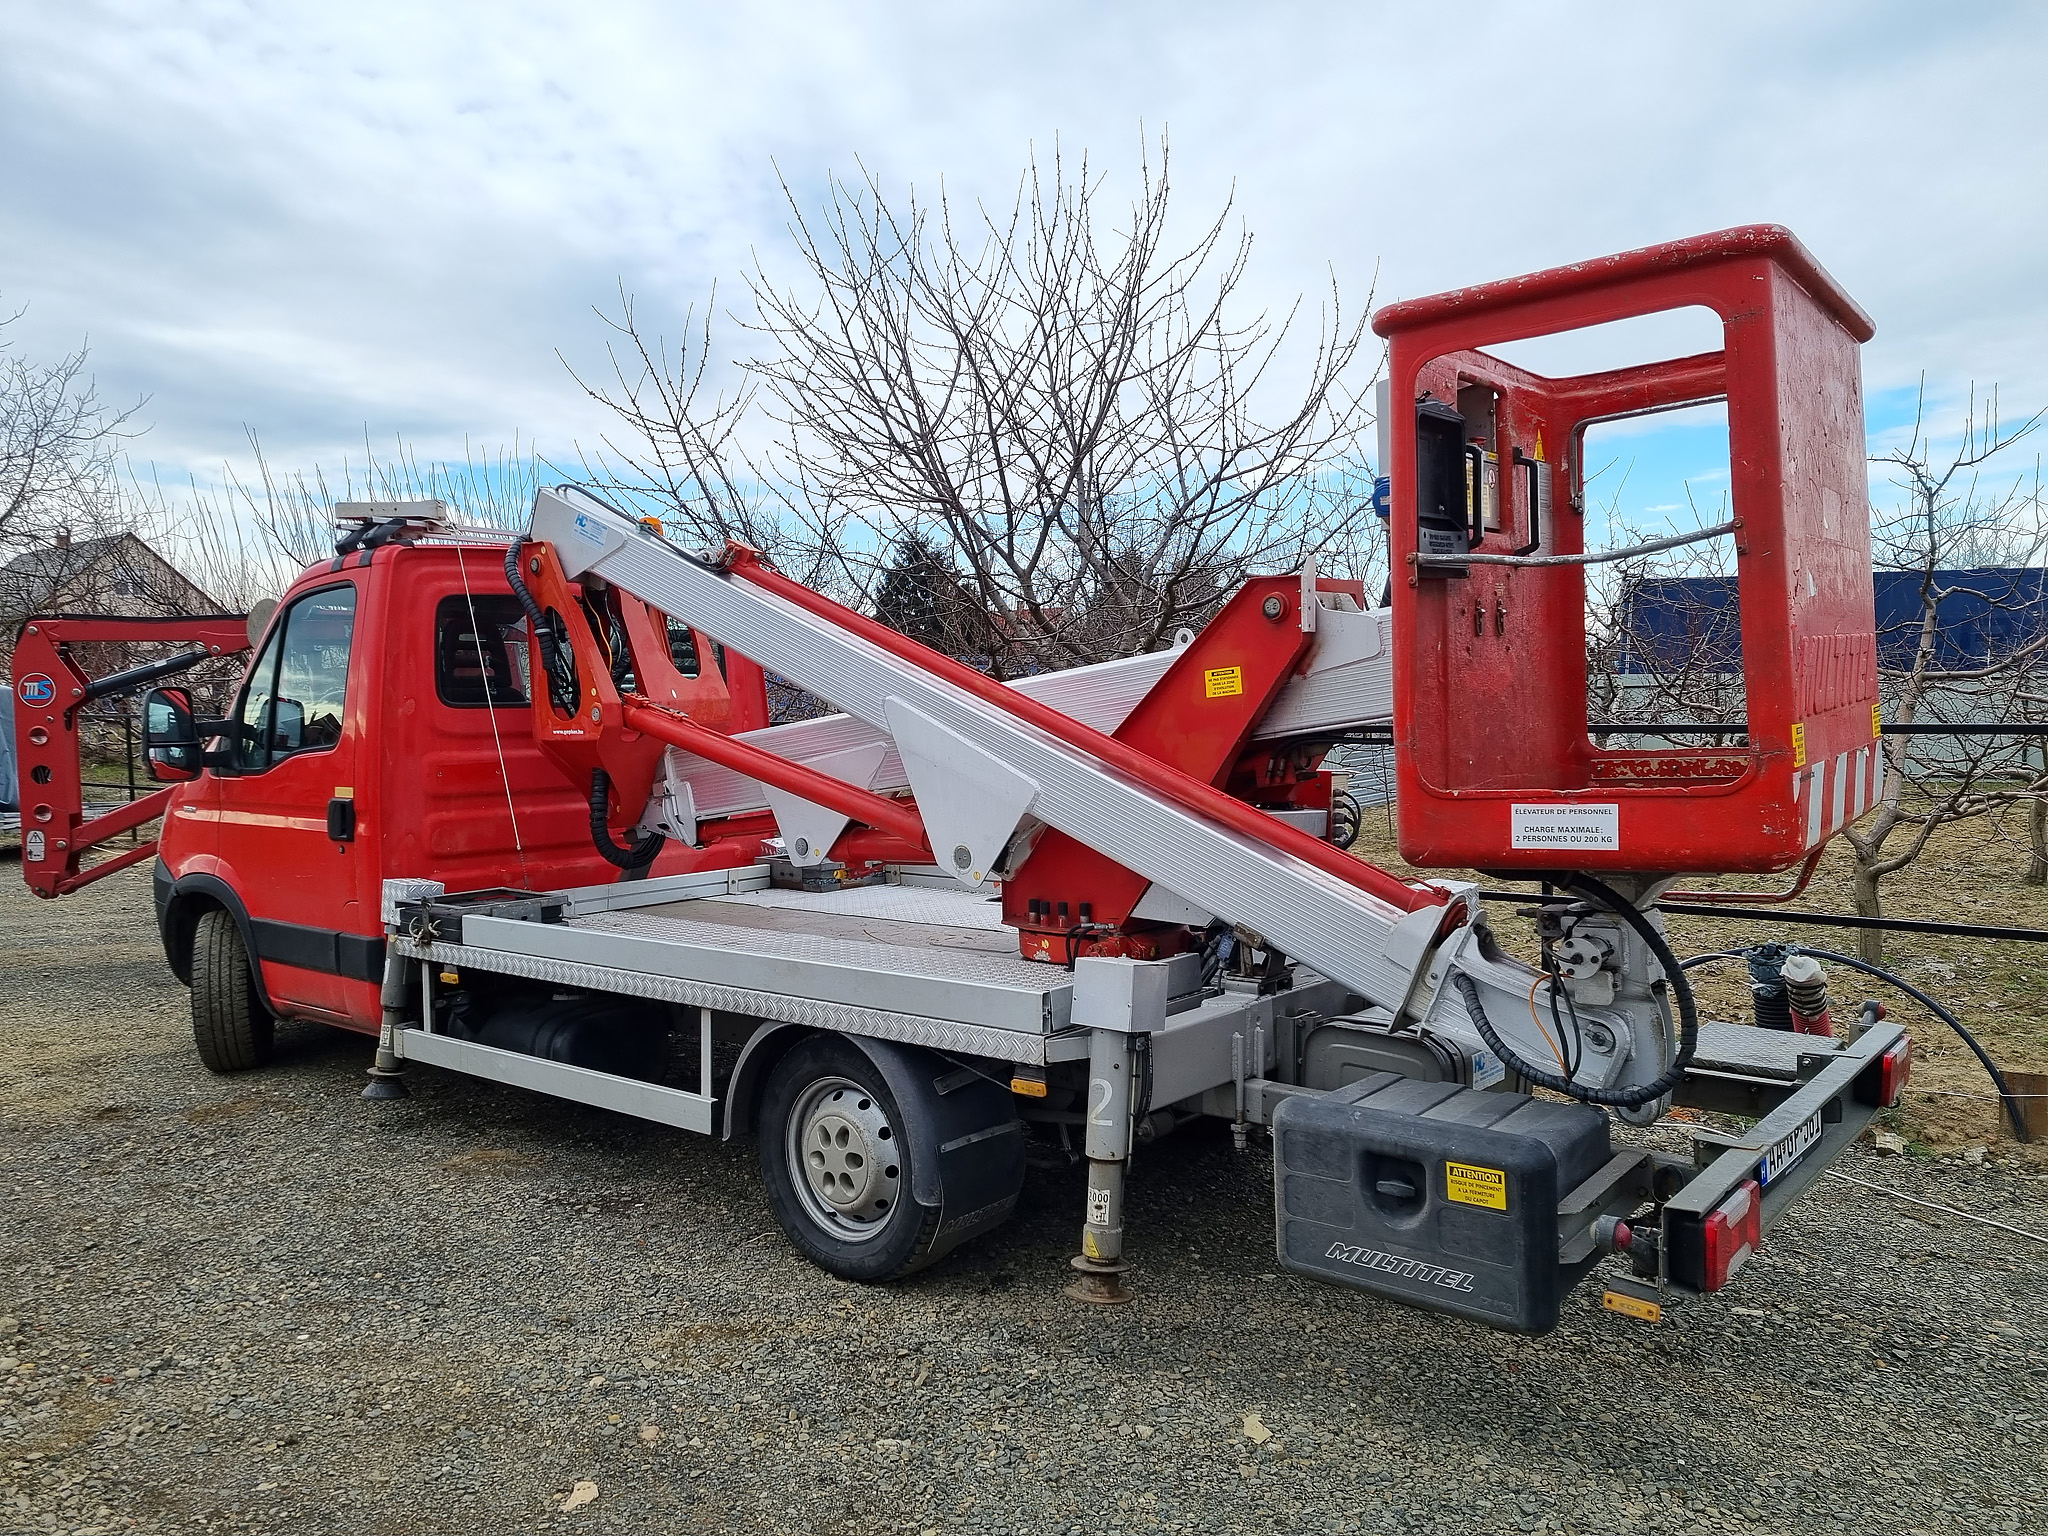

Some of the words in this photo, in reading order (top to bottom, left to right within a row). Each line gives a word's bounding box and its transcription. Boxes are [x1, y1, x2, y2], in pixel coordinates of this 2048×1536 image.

[1090, 1078, 1113, 1126] 2
[1452, 1168, 1499, 1183] ATTENTION
[1325, 1242, 1474, 1292] MULTITEL
